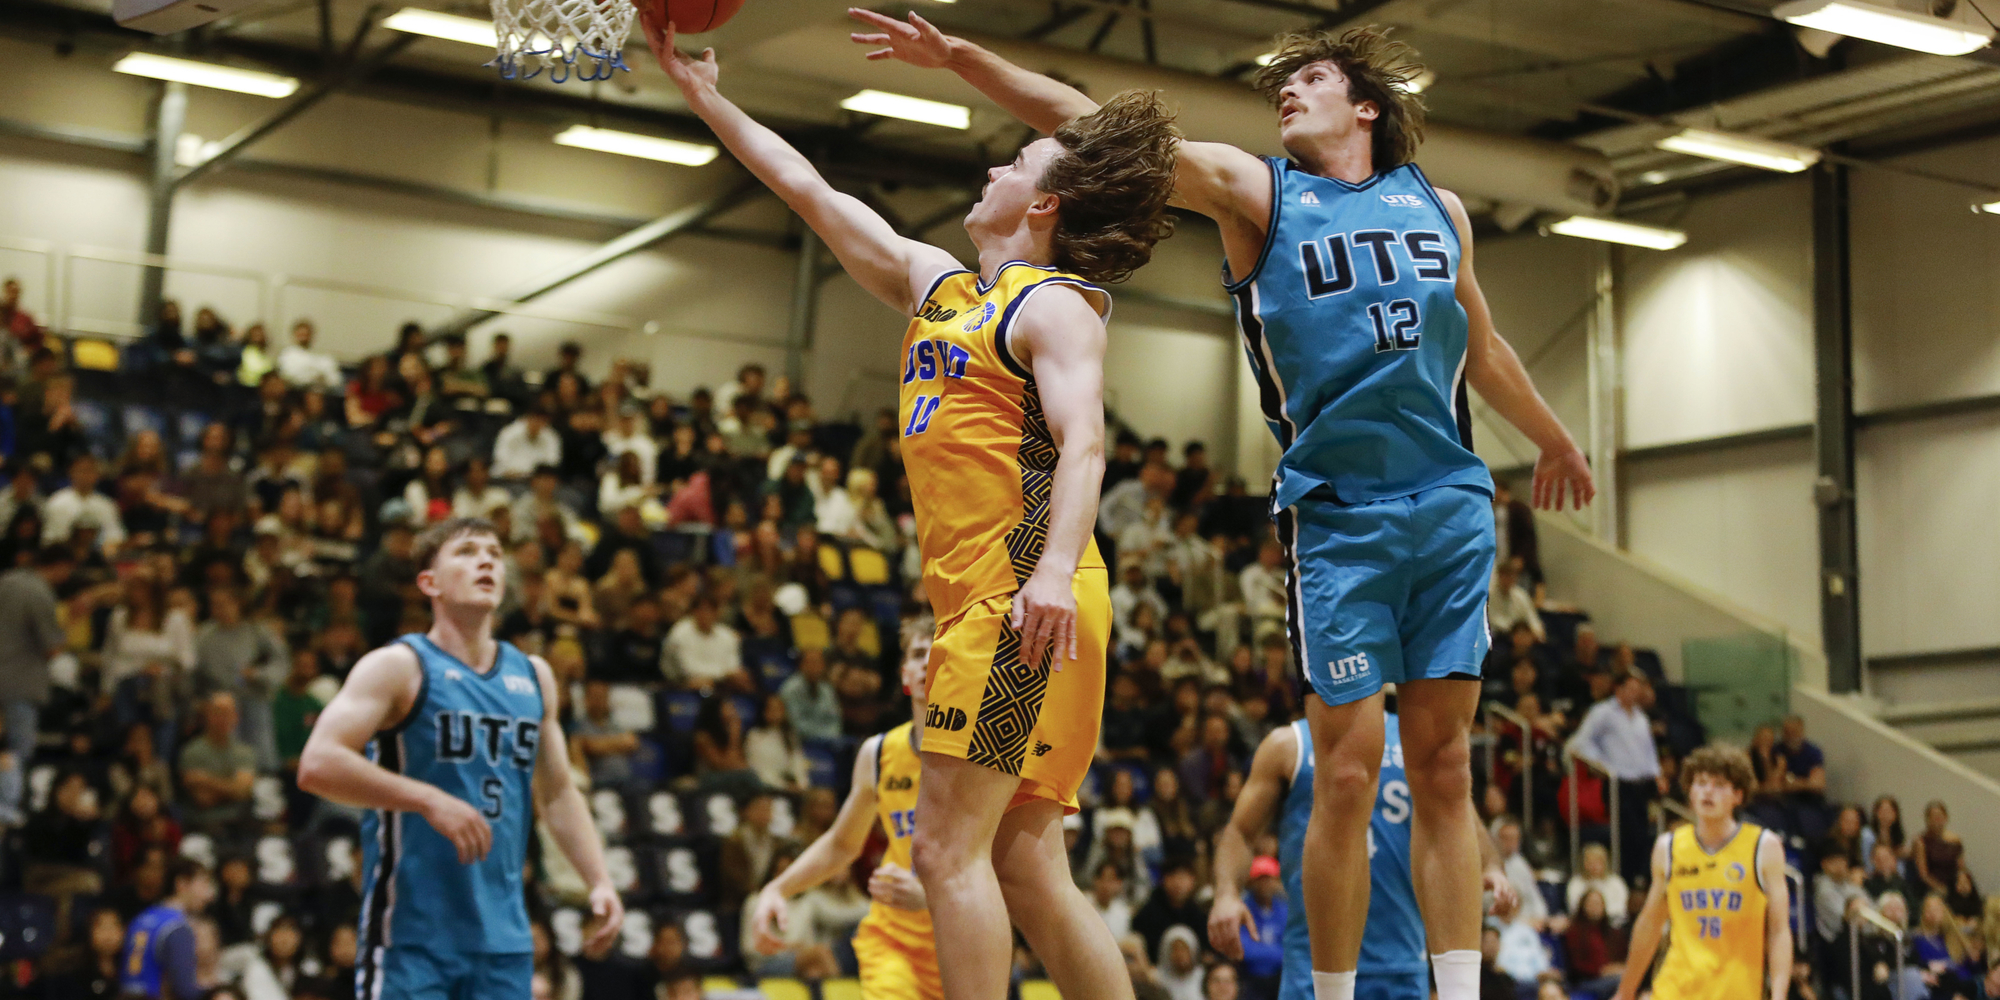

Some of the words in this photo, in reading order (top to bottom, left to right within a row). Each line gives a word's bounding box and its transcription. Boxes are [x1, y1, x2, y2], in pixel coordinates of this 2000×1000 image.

[1380, 194, 1423, 206] UTS
[1299, 228, 1454, 300] UTS
[1366, 298, 1421, 354] 12
[904, 394, 941, 438] 10
[1327, 651, 1370, 680] UTS
[434, 710, 540, 772] UTS
[1679, 888, 1743, 912] USYD
